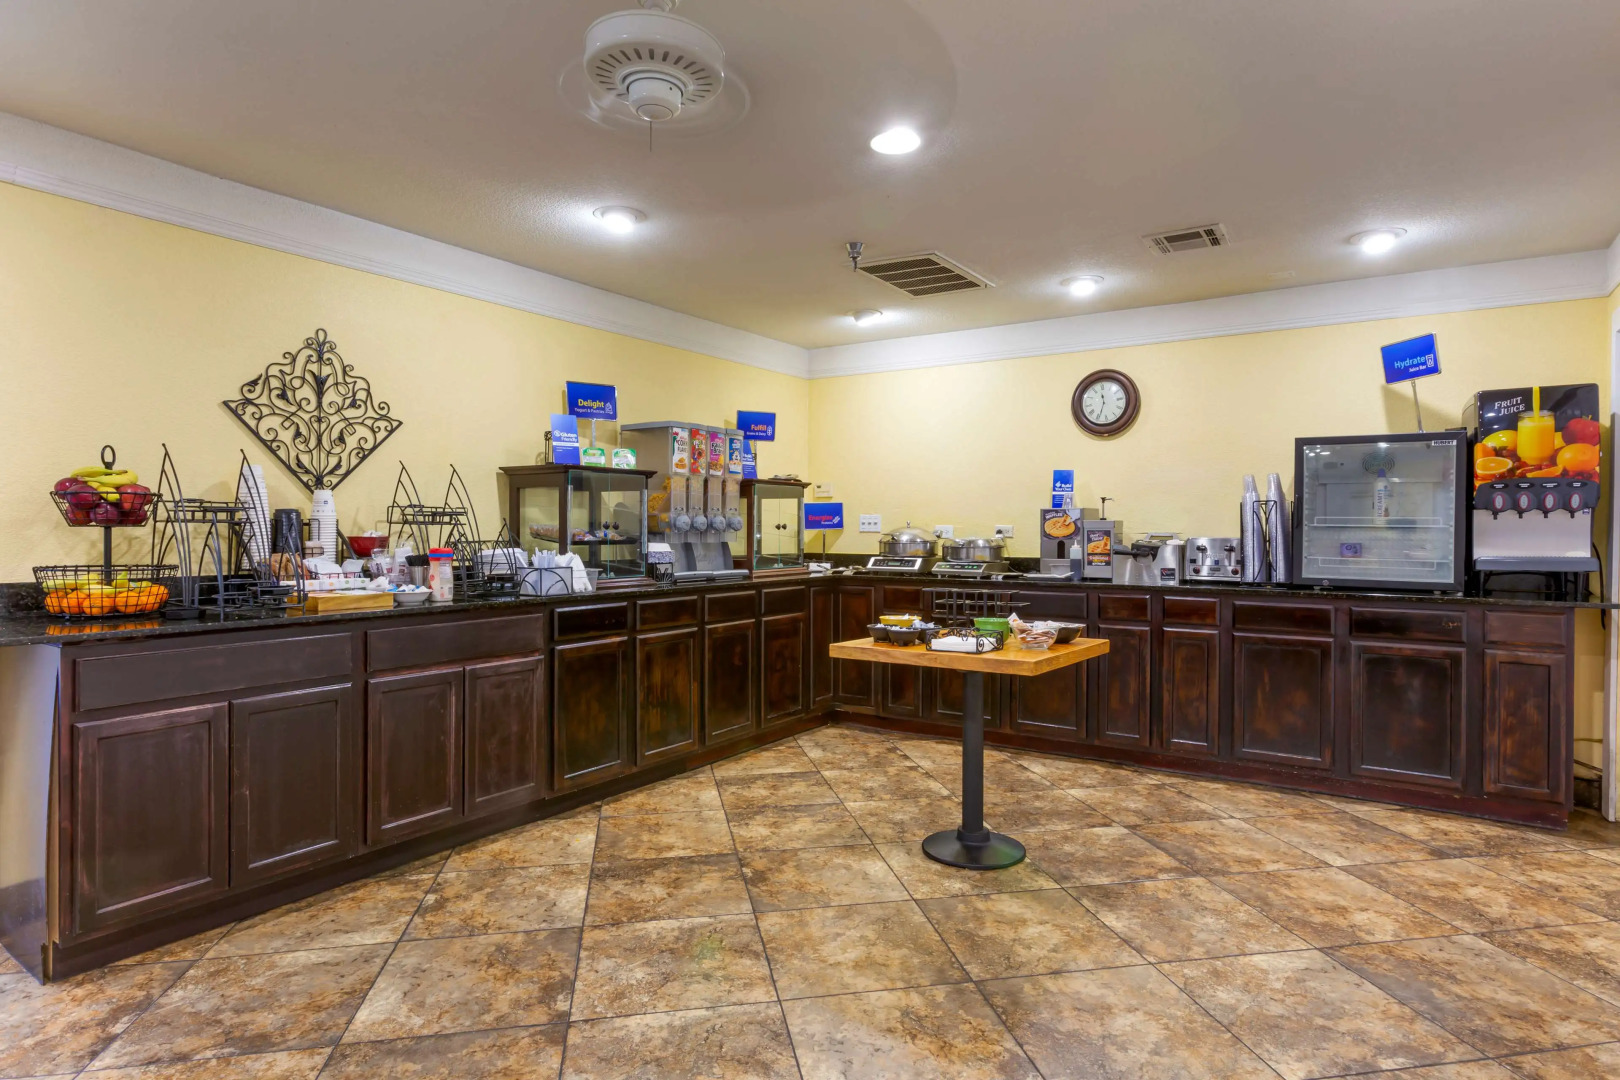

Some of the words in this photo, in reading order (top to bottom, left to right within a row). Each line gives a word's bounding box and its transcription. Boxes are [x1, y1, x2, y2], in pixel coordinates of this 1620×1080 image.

[1394, 356, 1426, 369] Hydrate
[578, 399, 604, 409] Delight
[1495, 397, 1522, 409] FRUIT
[1499, 404, 1526, 416] JUICE
